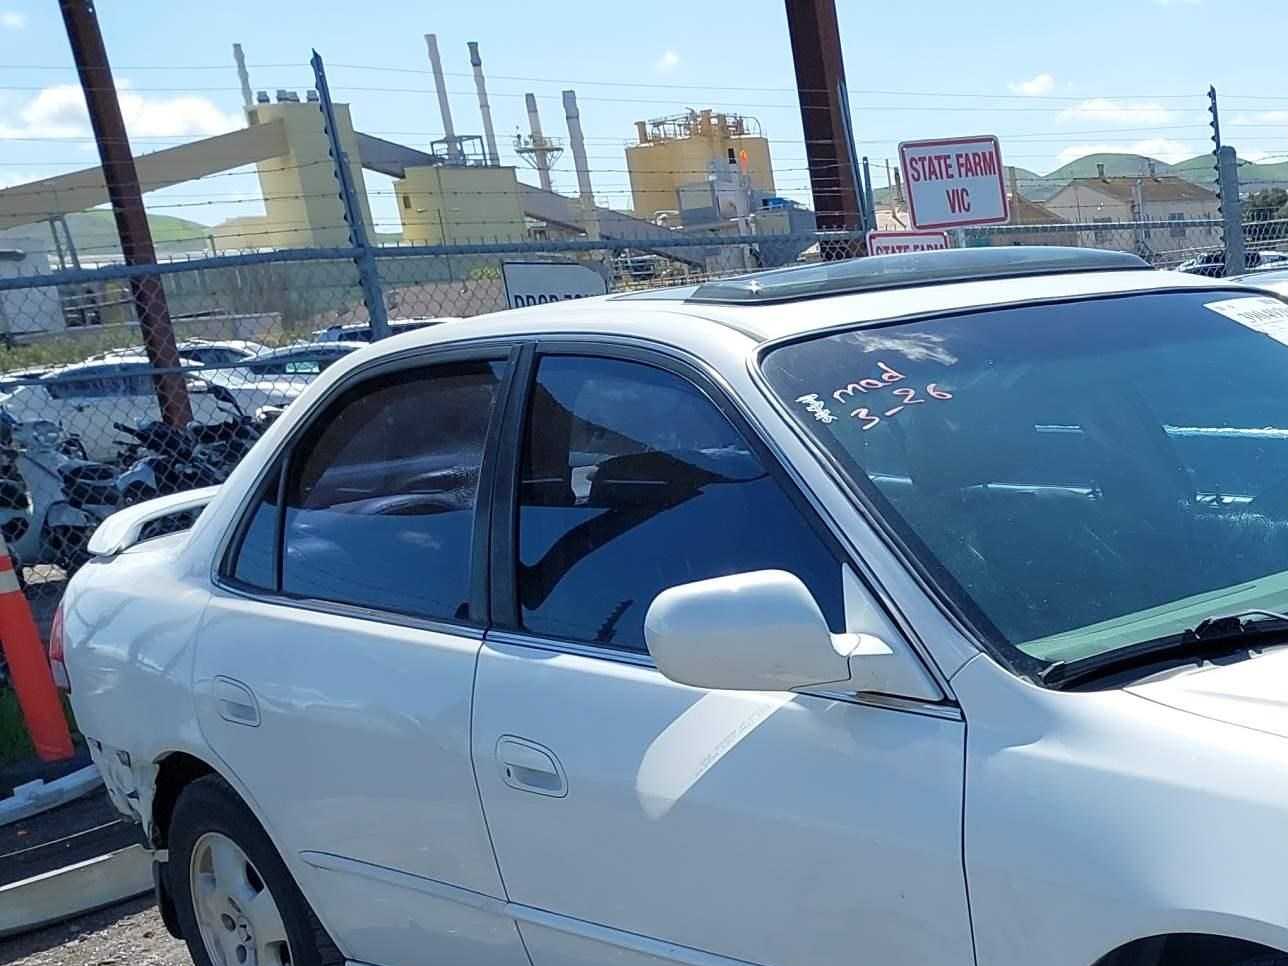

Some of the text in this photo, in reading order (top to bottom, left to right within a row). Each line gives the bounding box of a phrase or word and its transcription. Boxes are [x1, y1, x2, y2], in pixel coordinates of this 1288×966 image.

[909, 151, 997, 182] STATE FARM
[946, 188, 971, 214] VIC
